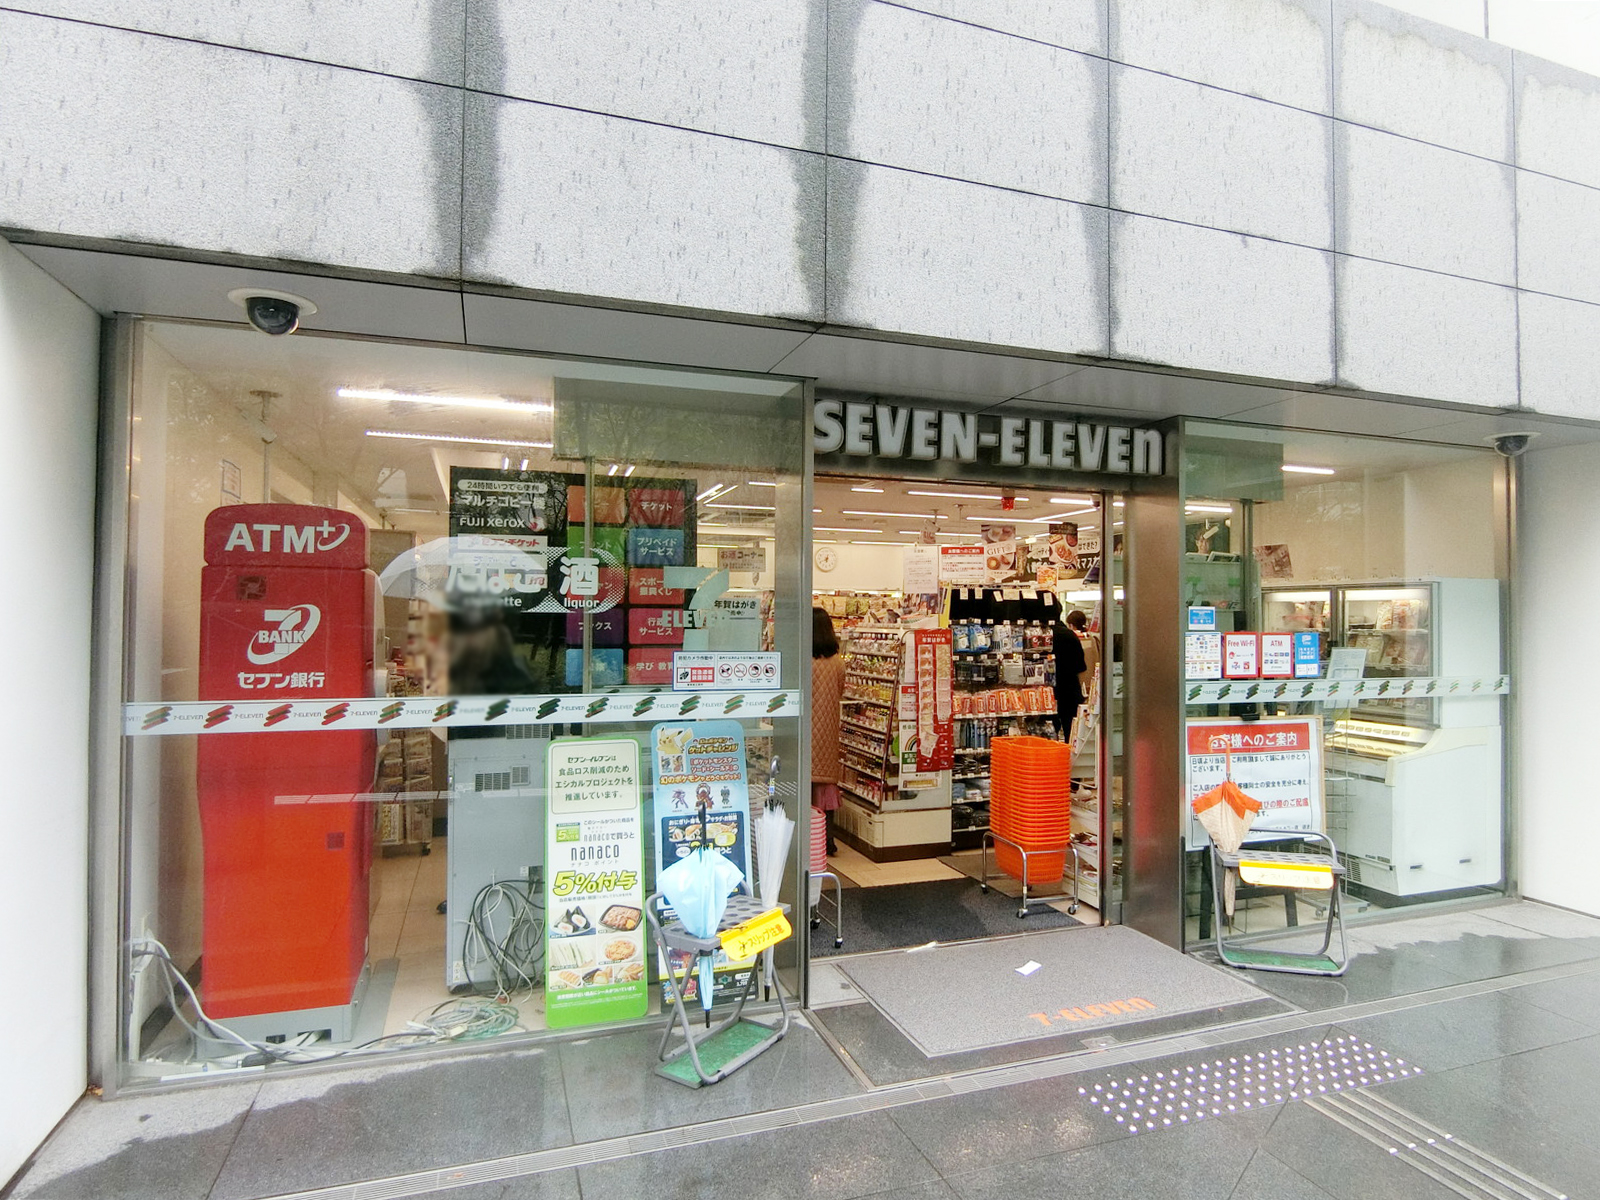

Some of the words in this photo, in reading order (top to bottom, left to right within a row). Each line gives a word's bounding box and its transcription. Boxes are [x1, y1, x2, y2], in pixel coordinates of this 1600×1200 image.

[466, 481, 540, 492] 24時間いつでも便利
[640, 501, 673, 511] チケット
[459, 517, 484, 527] FUJI
[636, 537, 678, 546] プリペイド
[640, 547, 674, 556] サービス
[559, 556, 600, 596] 酒
[639, 577, 665, 586] スポー
[563, 597, 600, 609] liquor
[714, 600, 757, 610] 年賀はがき
[258, 630, 306, 644] BANK
[638, 627, 674, 636] サービス
[1227, 639, 1240, 647] Free
[1240, 639, 1255, 647] Wi-Fi
[237, 671, 326, 690] セブン銀行
[558, 765, 631, 777] 食品ロス削減のため
[555, 776, 634, 789] エシカルプロジェクトを
[564, 790, 623, 802] 推進しています。
[570, 844, 620, 862] nanaco
[552, 870, 639, 897] 5%付与
[747, 924, 786, 947] スリップ注意
